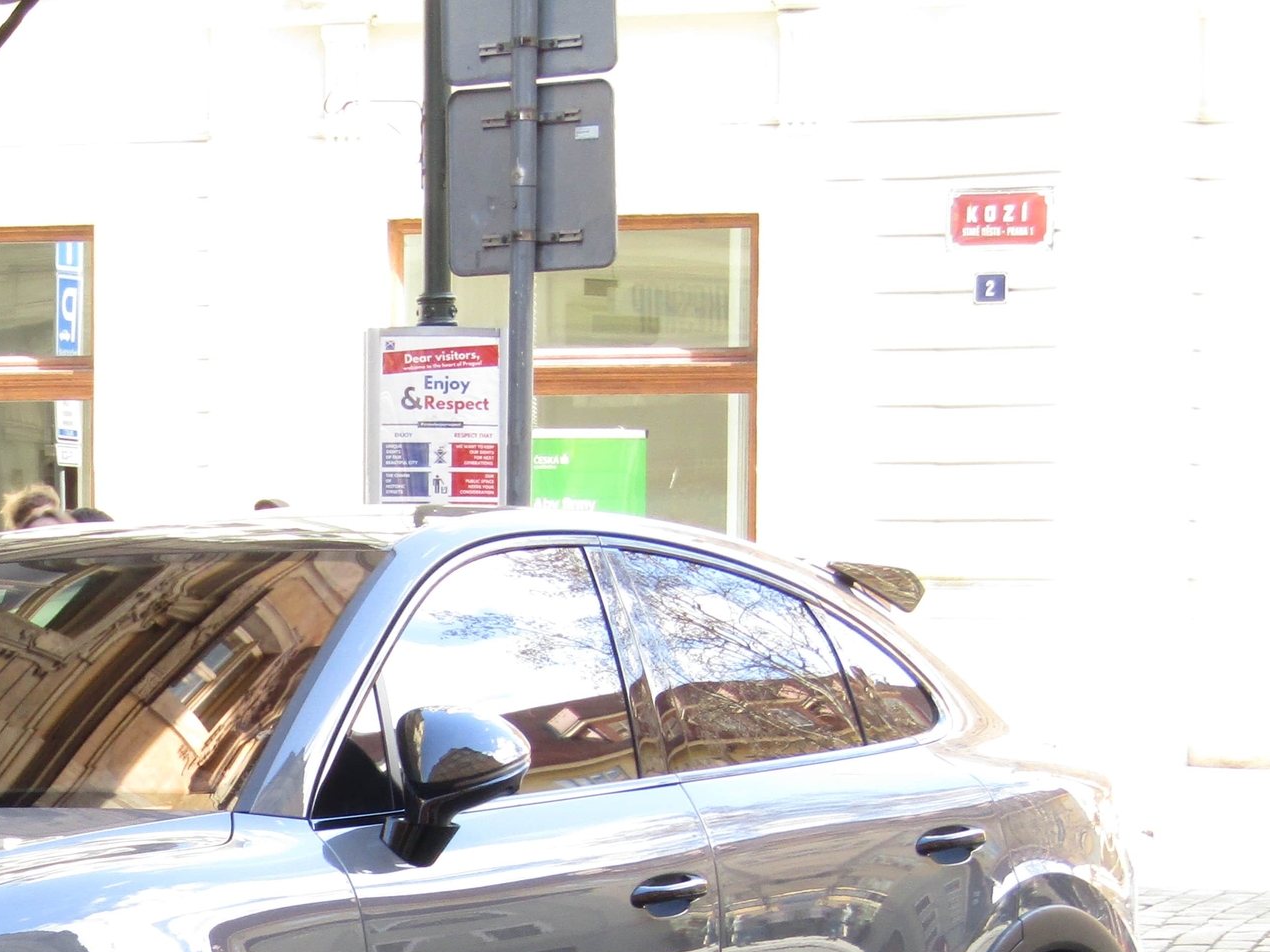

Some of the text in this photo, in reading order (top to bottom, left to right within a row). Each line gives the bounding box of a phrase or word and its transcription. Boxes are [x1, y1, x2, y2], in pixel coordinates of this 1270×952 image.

[966, 201, 1029, 223] KOZÍ
[985, 280, 996, 297] 2
[404, 350, 480, 364] Dear visitors,
[424, 375, 470, 394] Enjoy
[401, 386, 489, 414] & Respect
